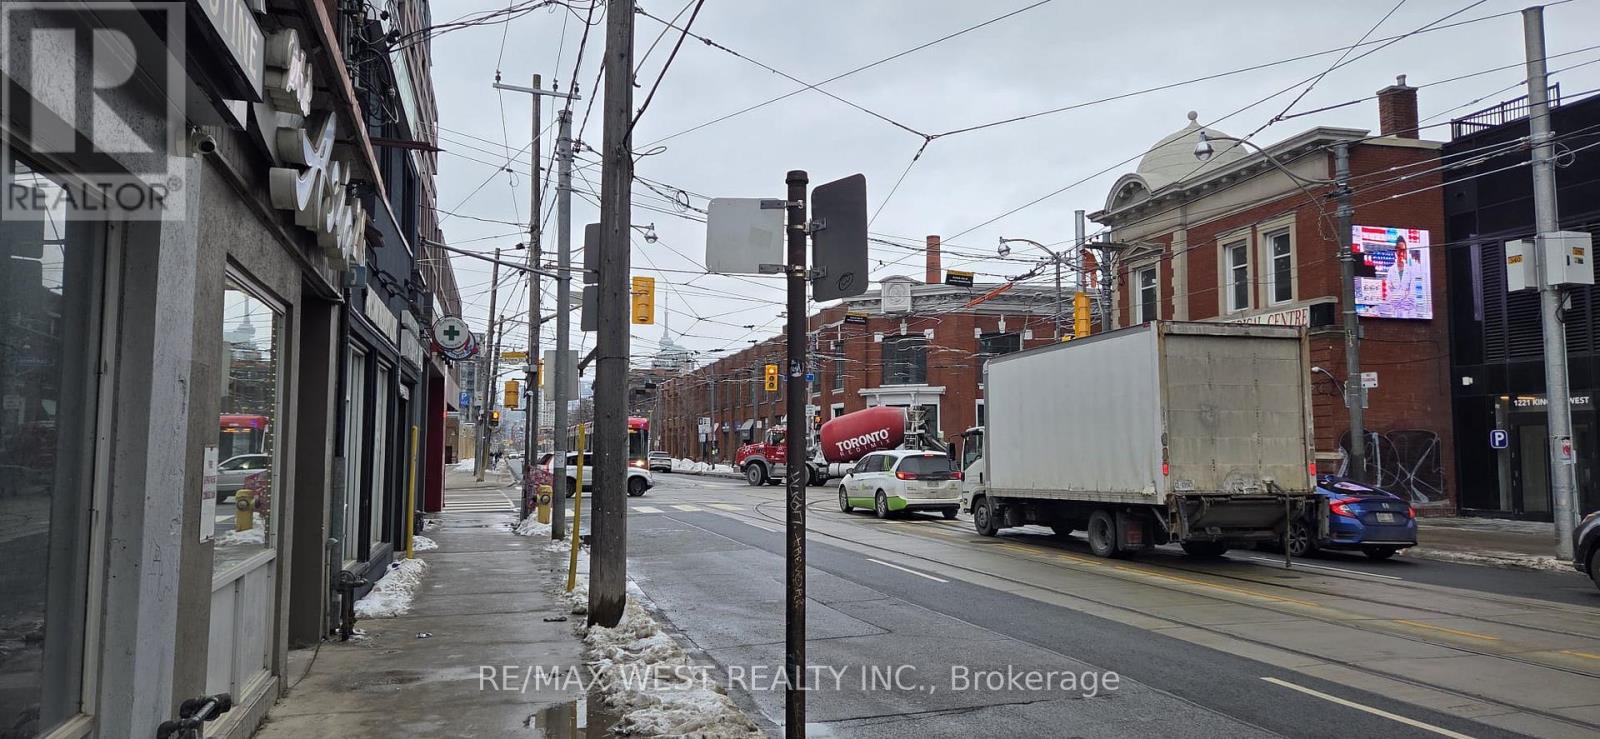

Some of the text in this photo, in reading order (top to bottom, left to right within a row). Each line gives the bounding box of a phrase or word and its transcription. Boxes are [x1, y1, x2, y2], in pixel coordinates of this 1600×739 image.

[1267, 308, 1309, 327] CENTRE
[1513, 399, 1531, 407] 1221
[1532, 398, 1548, 406] KIN
[835, 429, 889, 452] TORONTO
[1494, 431, 1505, 447] P
[839, 440, 890, 458] REDIMIX
